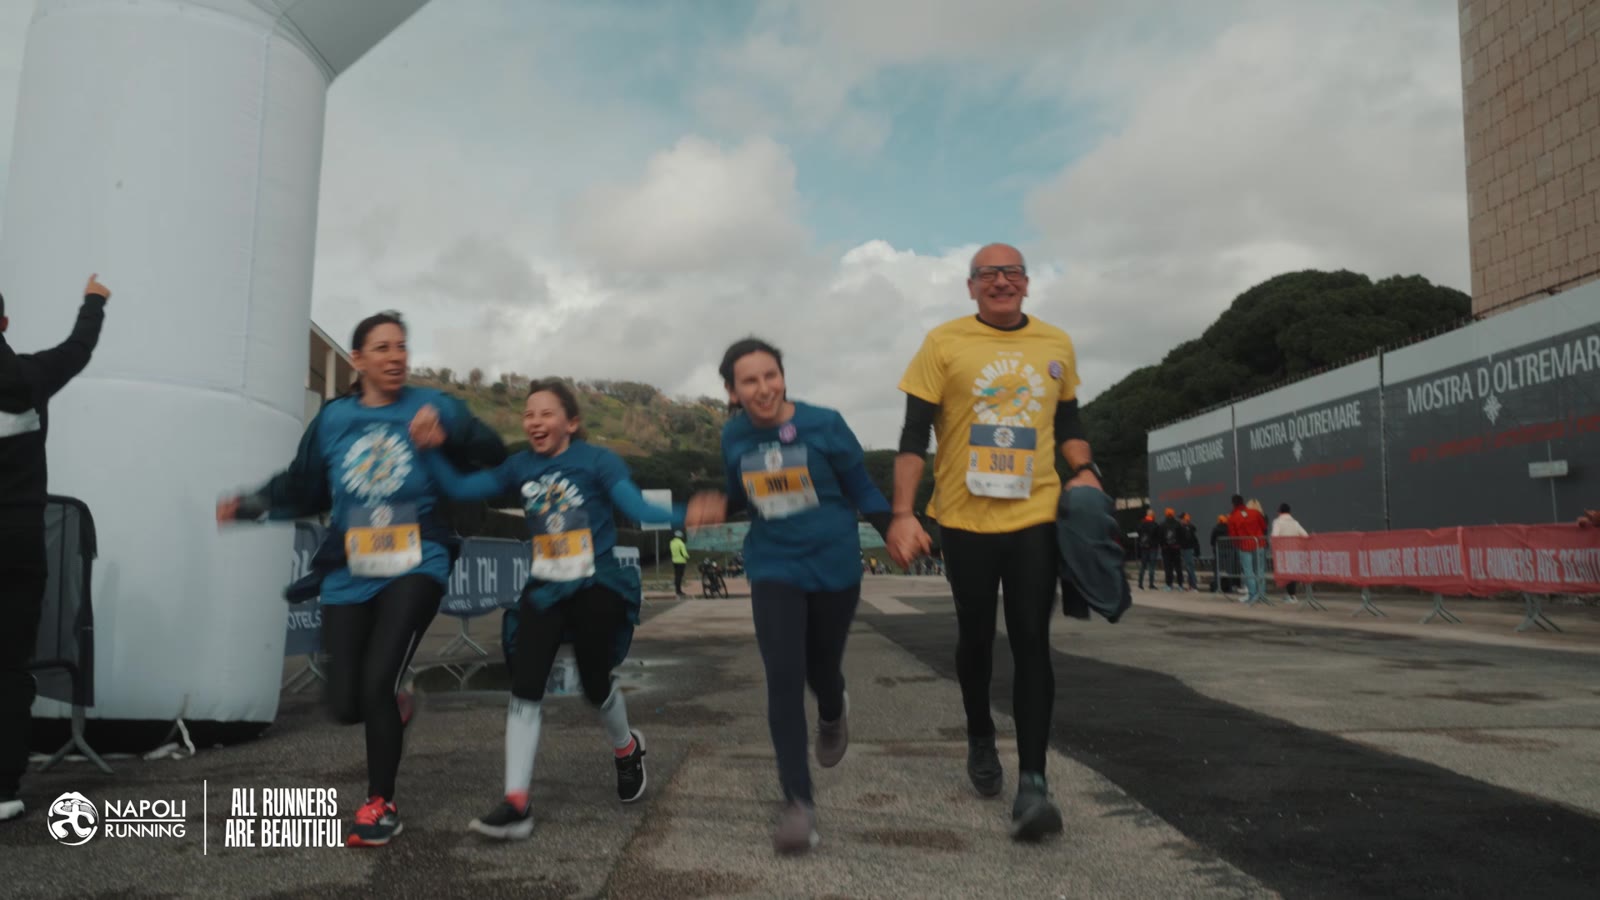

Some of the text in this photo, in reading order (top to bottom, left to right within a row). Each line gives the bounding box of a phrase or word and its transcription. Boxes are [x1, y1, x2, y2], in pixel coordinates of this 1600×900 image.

[1407, 372, 1474, 415] MOSTRA
[1249, 421, 1289, 450] MOSTRA
[989, 452, 1015, 472] 304
[1402, 546, 1418, 577] ARE
[1418, 544, 1464, 577] BEAUTIFUL
[1469, 547, 1487, 580] ALL
[1486, 547, 1536, 583] RUNNERS
[1535, 548, 1561, 584] ARE
